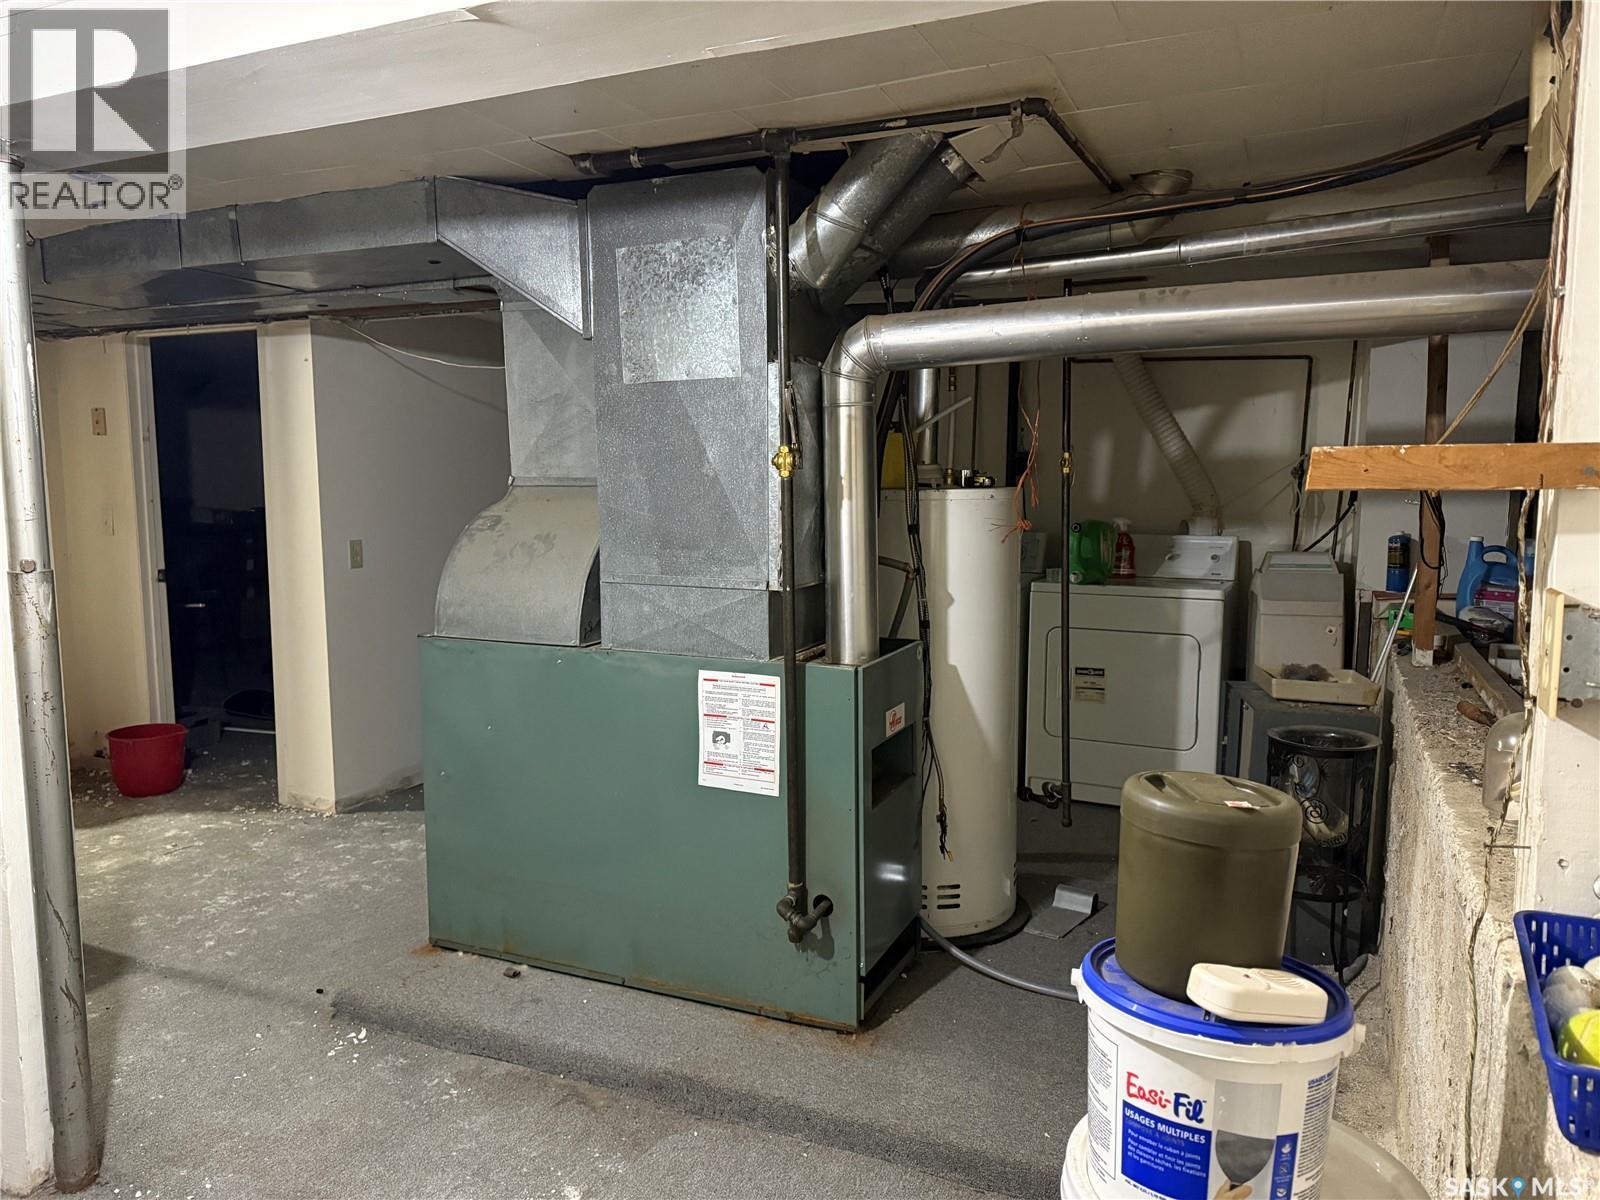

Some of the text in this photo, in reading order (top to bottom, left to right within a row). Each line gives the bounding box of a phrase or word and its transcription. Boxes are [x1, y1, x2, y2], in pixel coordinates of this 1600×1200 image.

[1124, 1107, 1156, 1129] USAGES
[1157, 1122, 1206, 1145] MULTIPLES
[1127, 1129, 1139, 1139] Pour
[1127, 1138, 1139, 1148] Pour
